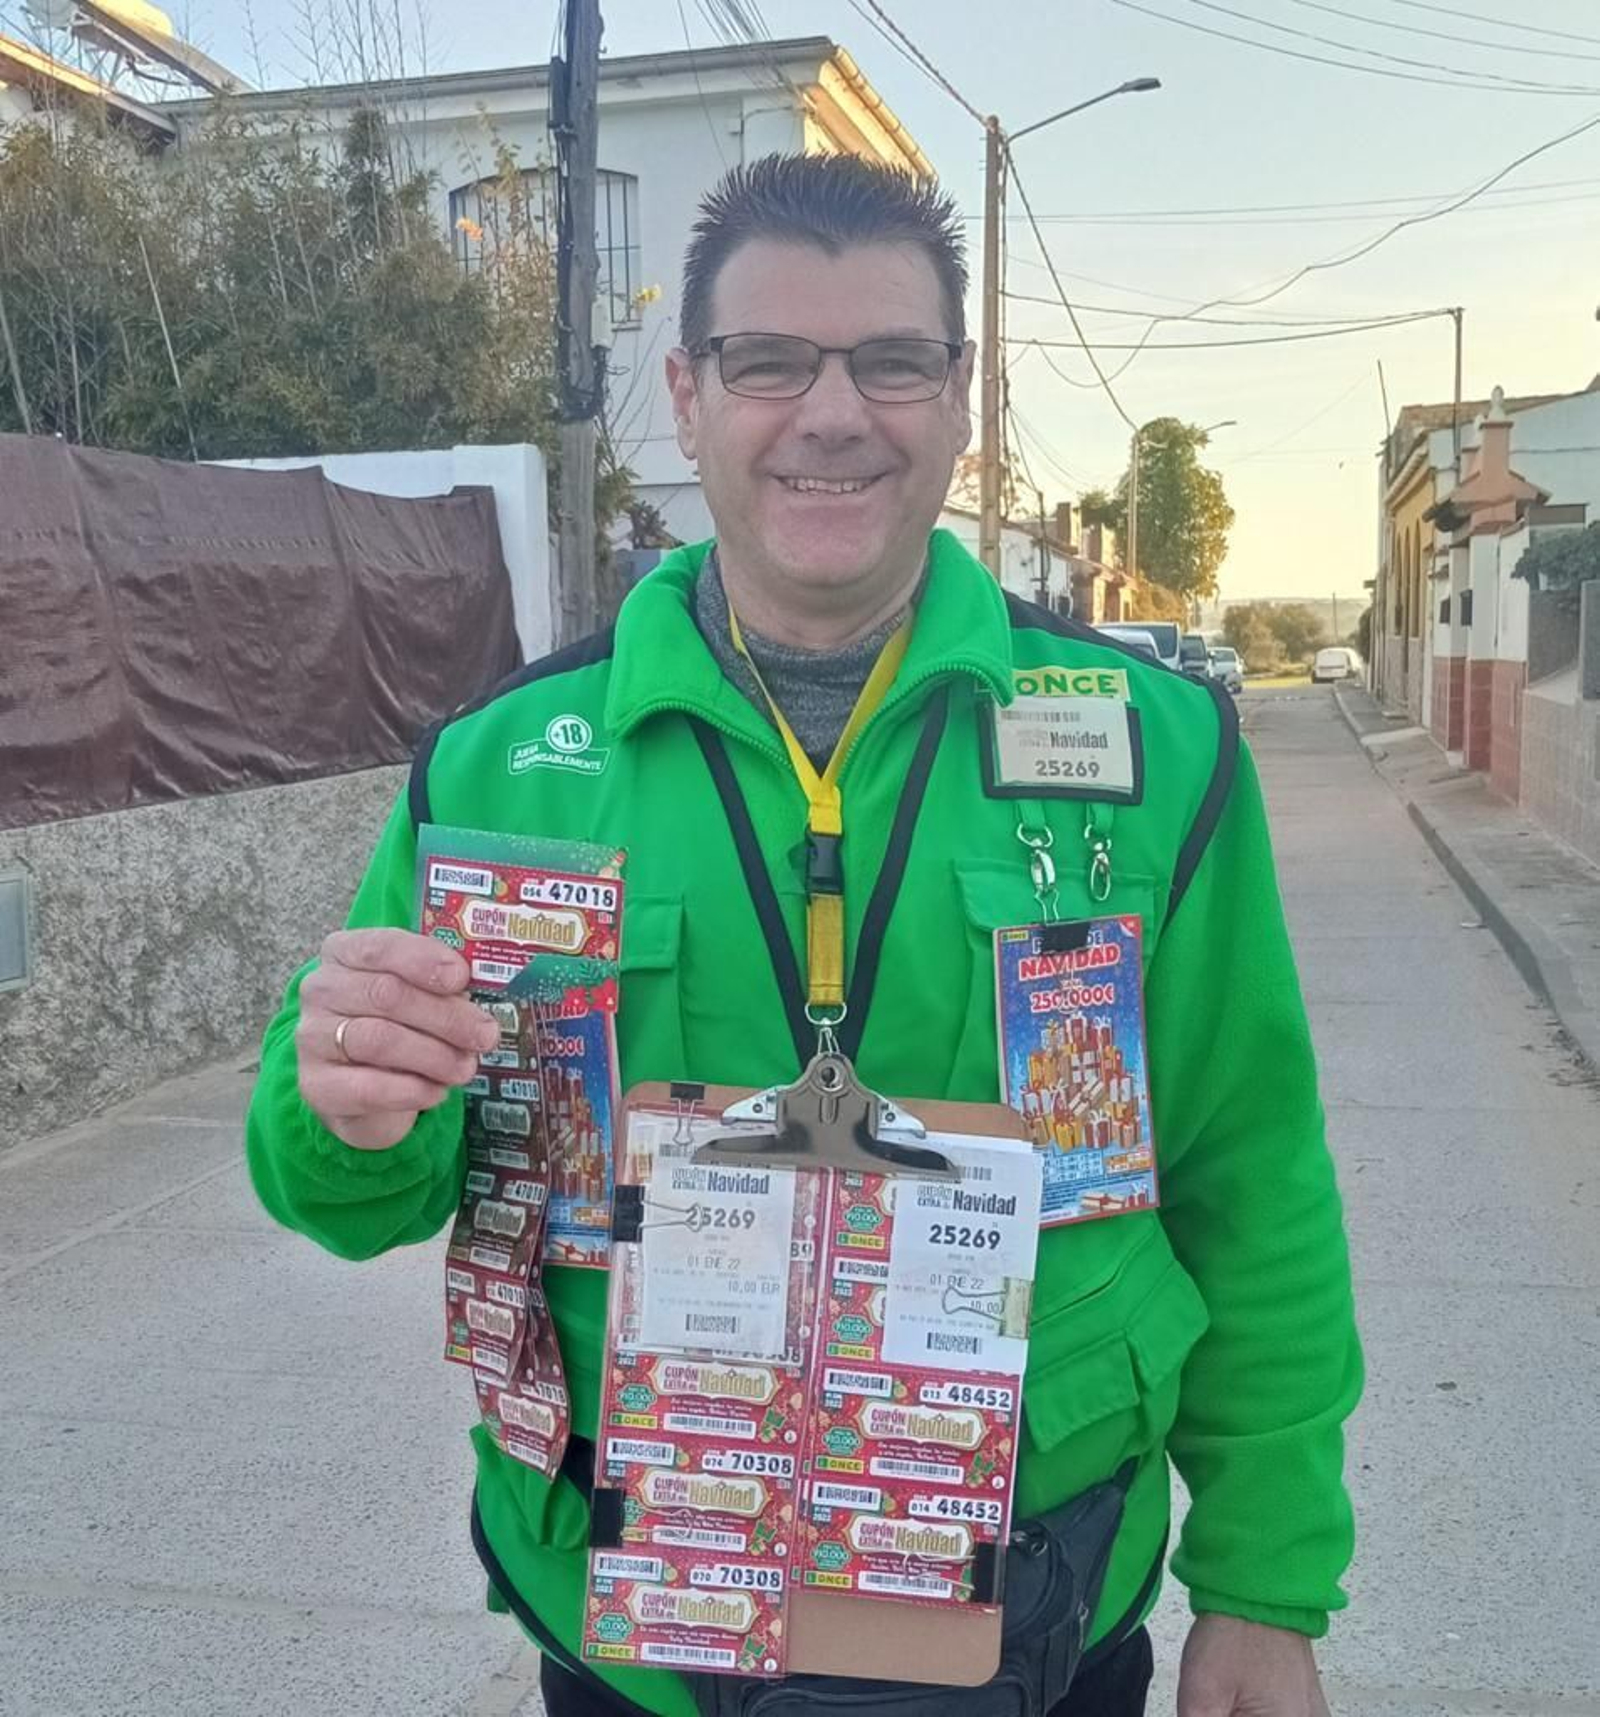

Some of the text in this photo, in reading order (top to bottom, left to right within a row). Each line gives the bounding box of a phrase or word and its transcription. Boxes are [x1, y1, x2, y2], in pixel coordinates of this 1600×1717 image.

[1015, 673, 1119, 696] ONCE
[552, 723, 583, 745] +18
[1050, 731, 1109, 749] Navidad
[1034, 759, 1100, 778] 25269
[548, 882, 614, 908] 47018
[471, 906, 576, 943] CUPÓN Navidad
[471, 922, 495, 936] EXTRA
[1019, 943, 1121, 981] NAVIDAD
[707, 1170, 770, 1195] Navidad
[953, 1190, 1017, 1216] Navidad
[685, 1206, 756, 1230] 25269
[928, 1223, 1001, 1250] 25269
[664, 1364, 699, 1381] CUPÓN
[948, 1385, 1010, 1409] 48452
[870, 1422, 895, 1434] EXTRA
[871, 1407, 974, 1444] CUPÓN Navidad
[731, 1452, 792, 1475] 70308
[653, 1477, 756, 1511] CUPÓN Navidad
[936, 1498, 1000, 1521] 48452
[859, 1522, 963, 1556] CUPÓN Navidad
[719, 1566, 781, 1588] 70308
[640, 1606, 665, 1618] EXTRA
[641, 1592, 745, 1625] CUPÓN Navidad
